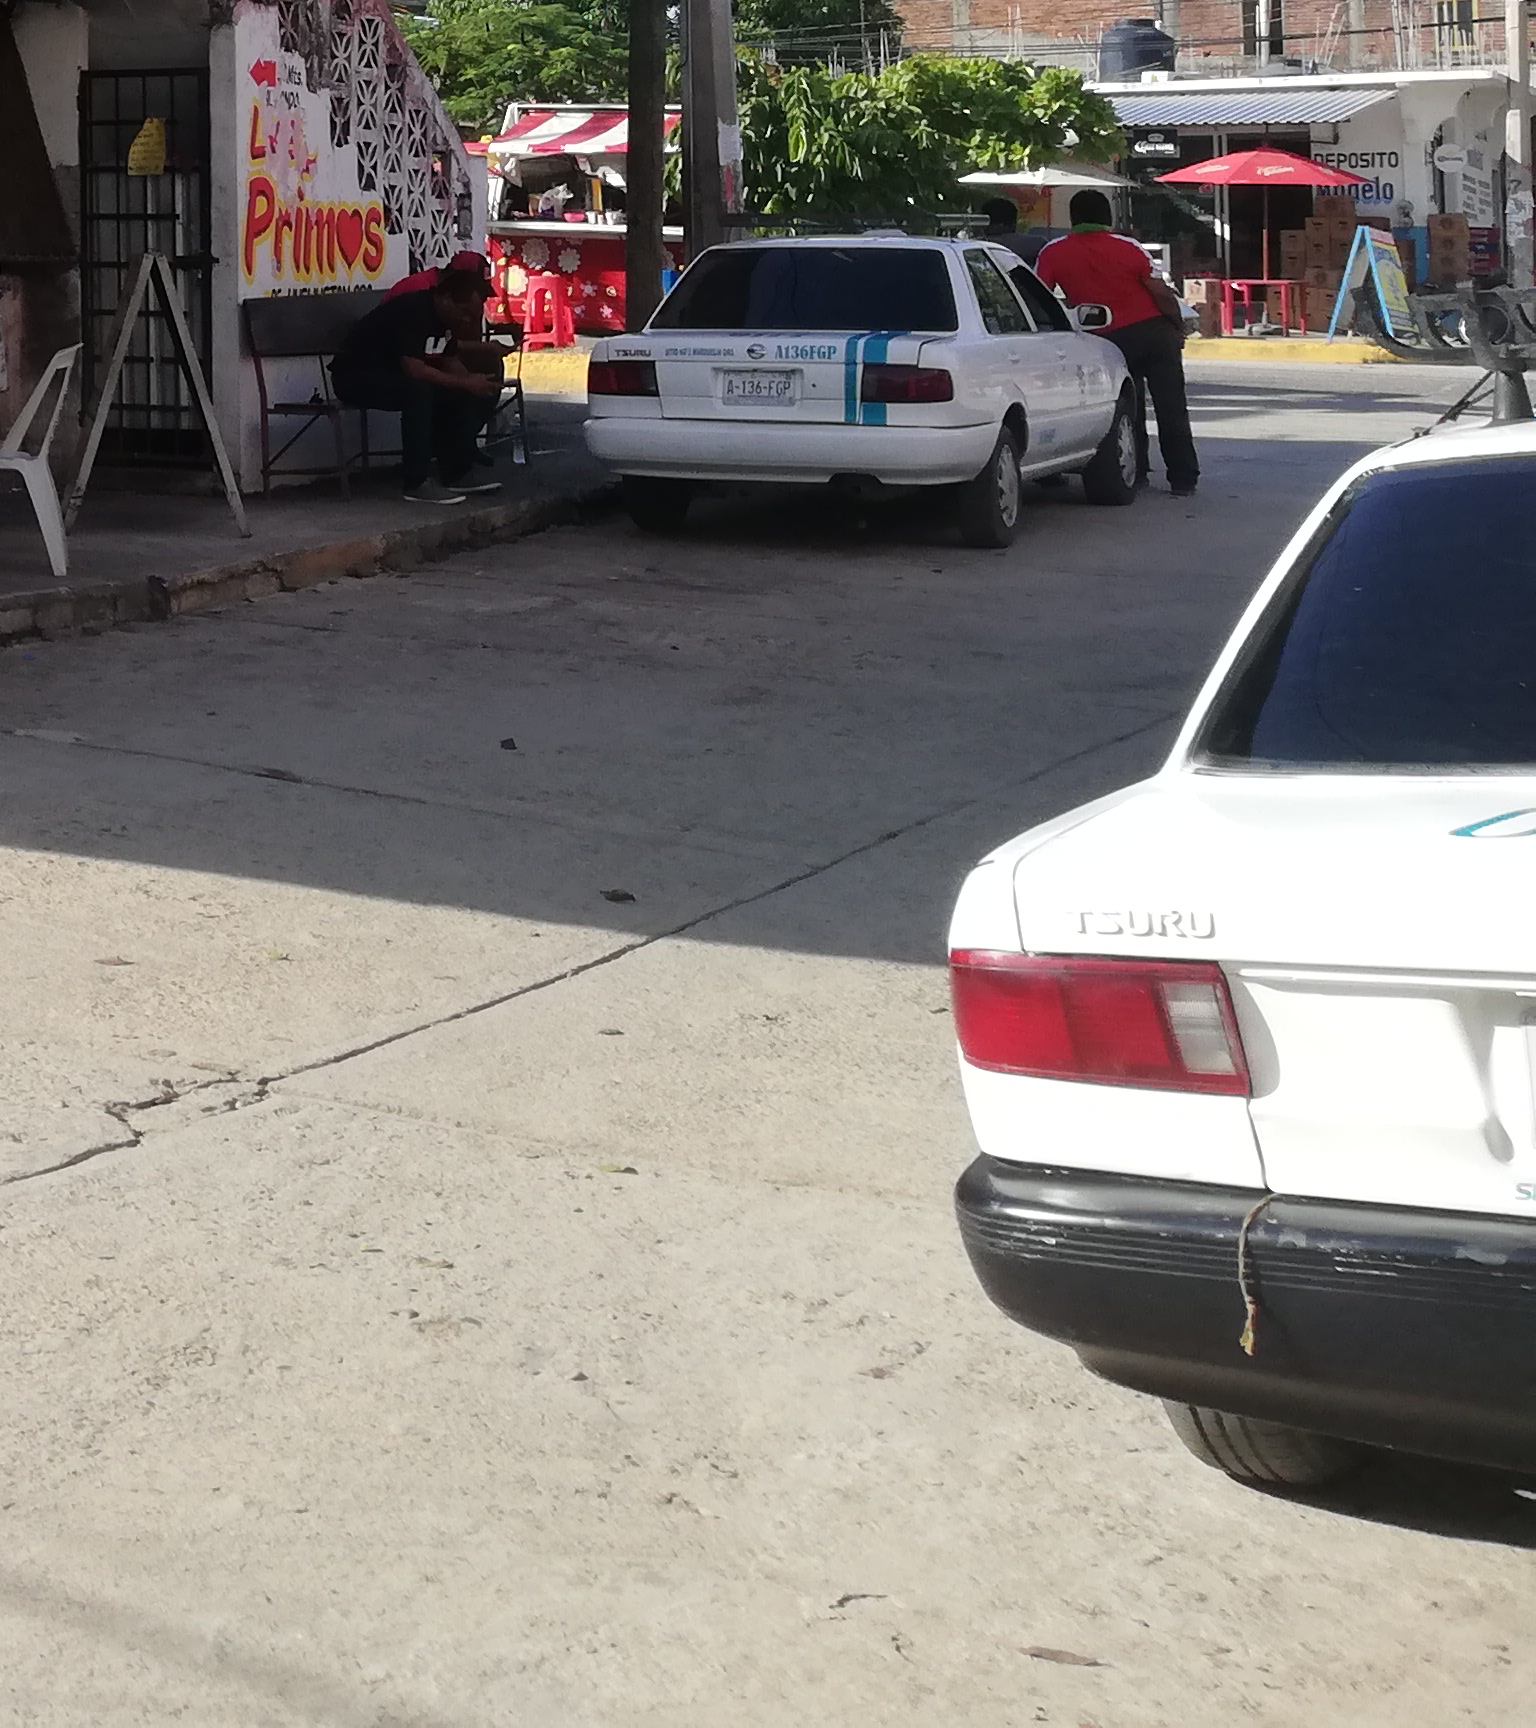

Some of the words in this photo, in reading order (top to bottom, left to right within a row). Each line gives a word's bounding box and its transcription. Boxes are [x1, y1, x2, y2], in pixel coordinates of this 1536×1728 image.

[614, 349, 652, 358] TSURU
[774, 344, 838, 360] A136FGP
[727, 379, 791, 396] A-136-FGP
[1066, 909, 1218, 940] TSURU
